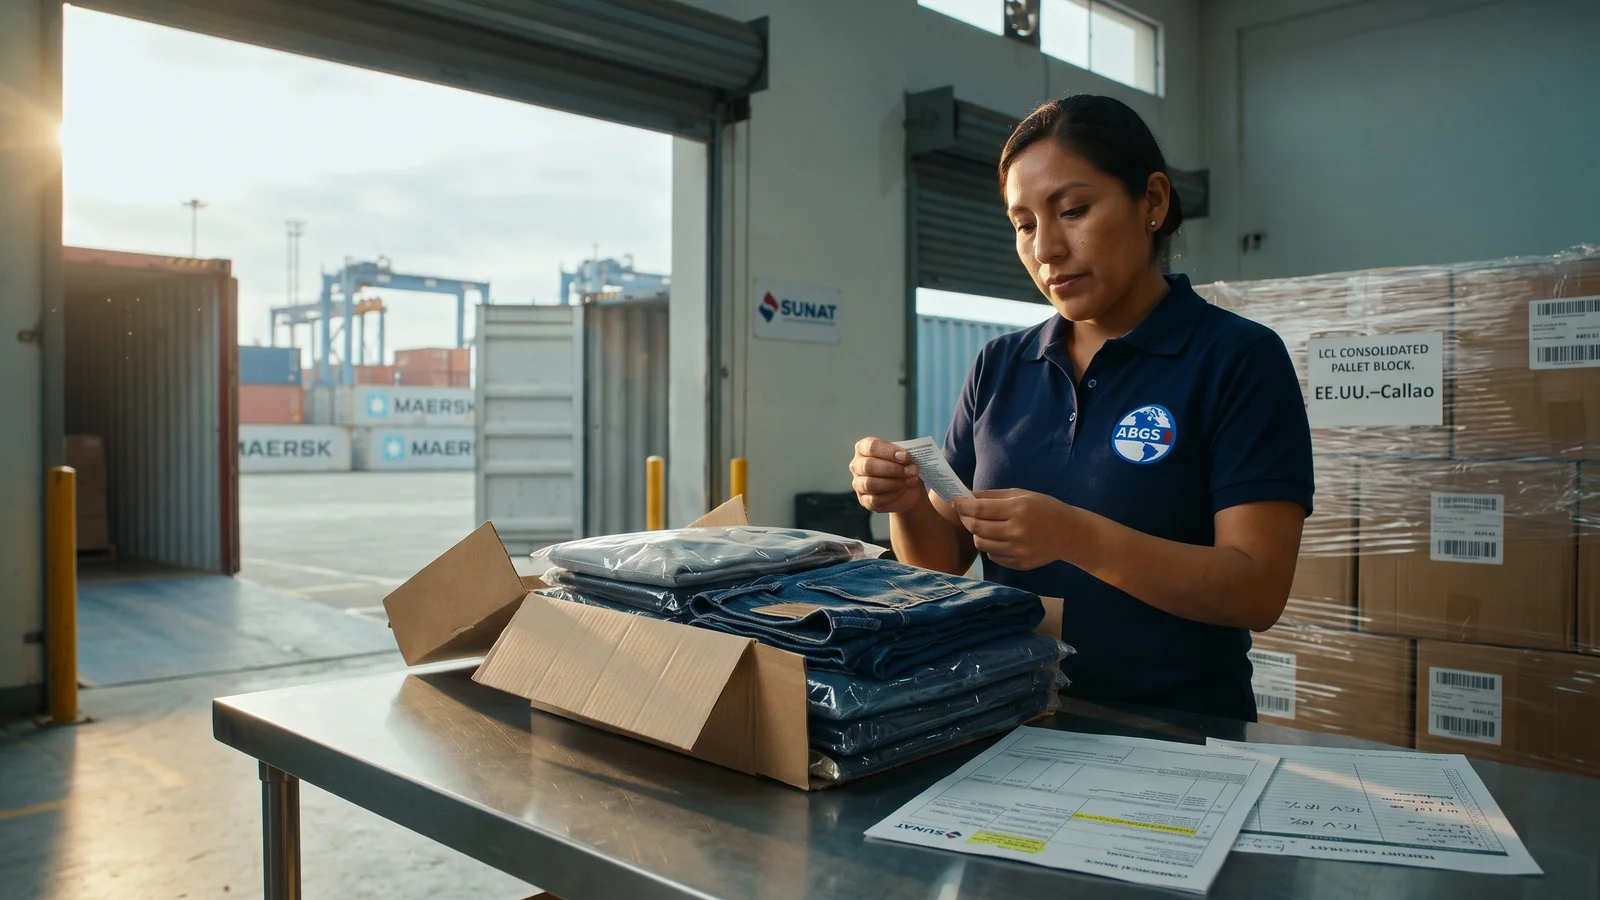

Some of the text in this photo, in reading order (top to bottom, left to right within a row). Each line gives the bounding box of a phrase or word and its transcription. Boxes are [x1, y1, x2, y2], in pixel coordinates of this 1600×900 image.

[781, 299, 837, 320] SUNAT
[1319, 344, 1429, 359] LCL CONSOLIDATED
[1331, 360, 1415, 373] PALLET BLOCK.
[1115, 427, 1161, 441] ABGS
[893, 823, 945, 836] SUNAT
